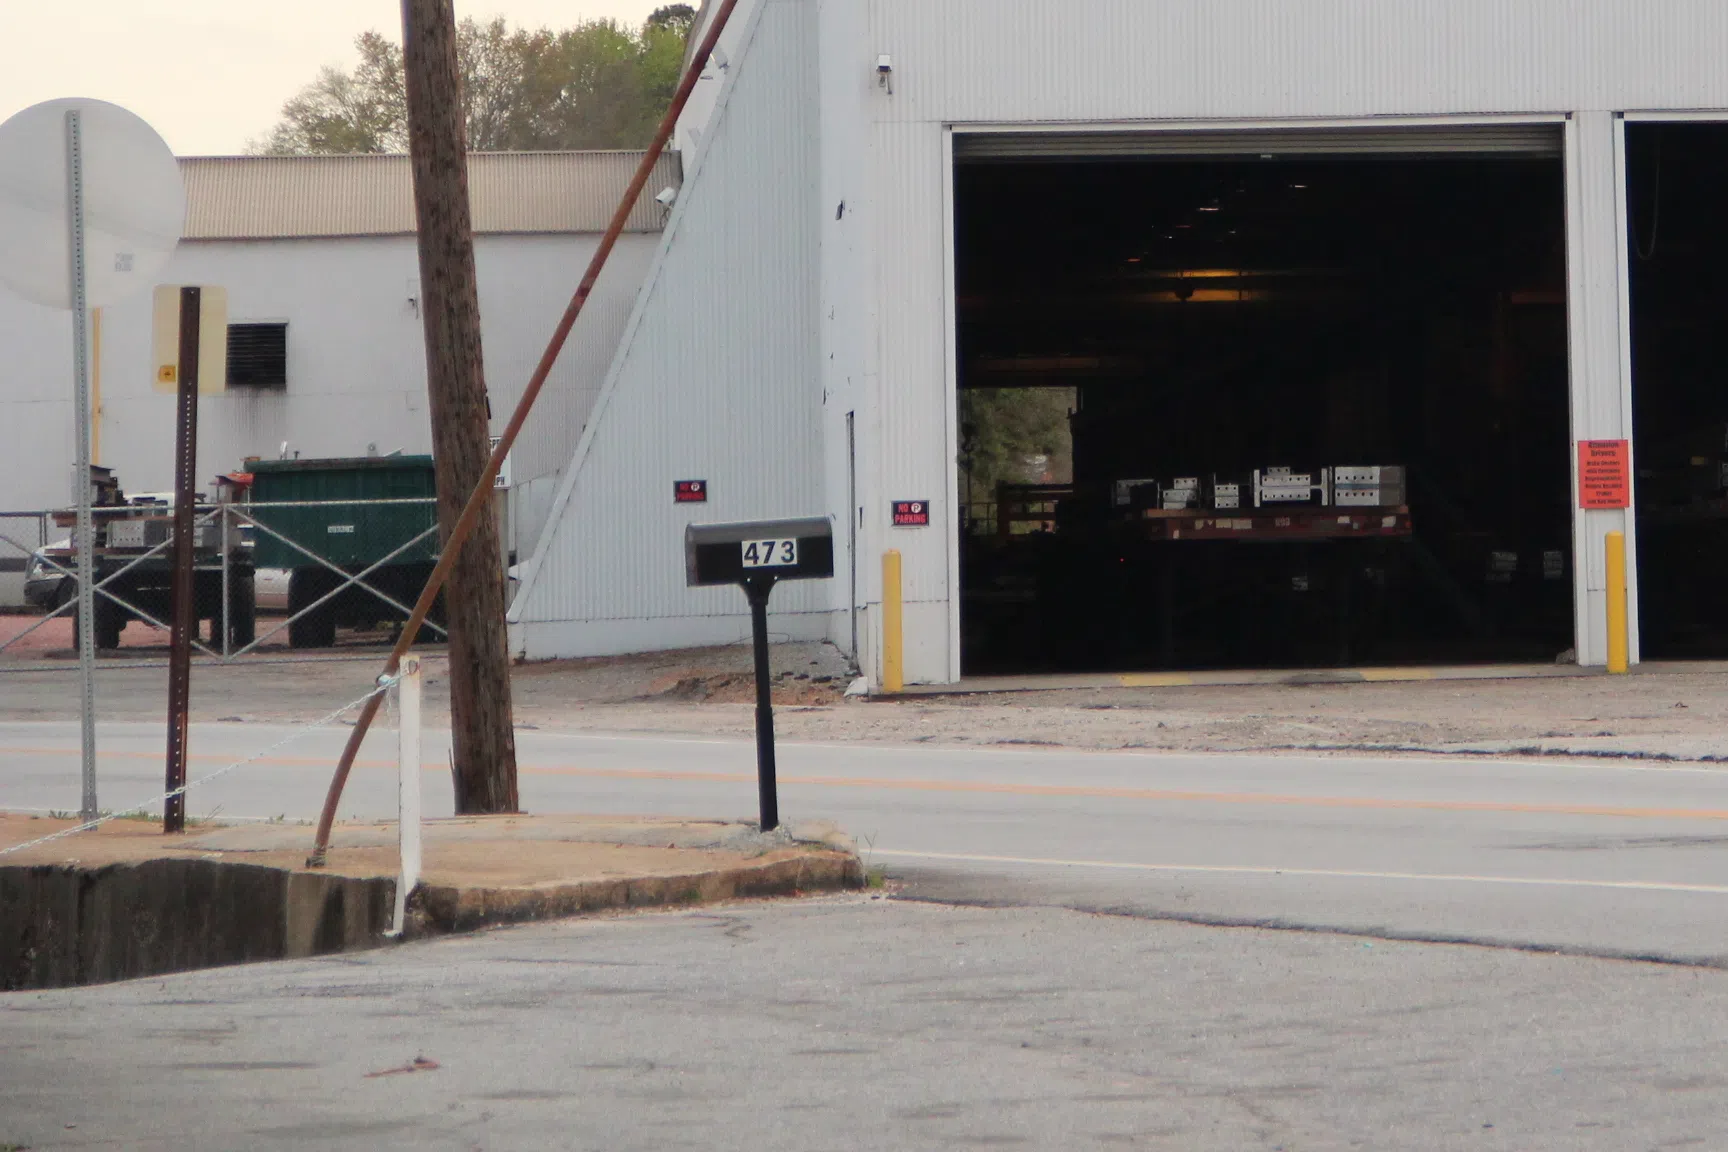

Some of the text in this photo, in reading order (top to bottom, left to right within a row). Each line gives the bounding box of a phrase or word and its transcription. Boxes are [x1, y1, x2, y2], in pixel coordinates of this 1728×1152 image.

[898, 503, 909, 513] NO
[894, 514, 926, 524] PARKING
[743, 540, 795, 565] 473
